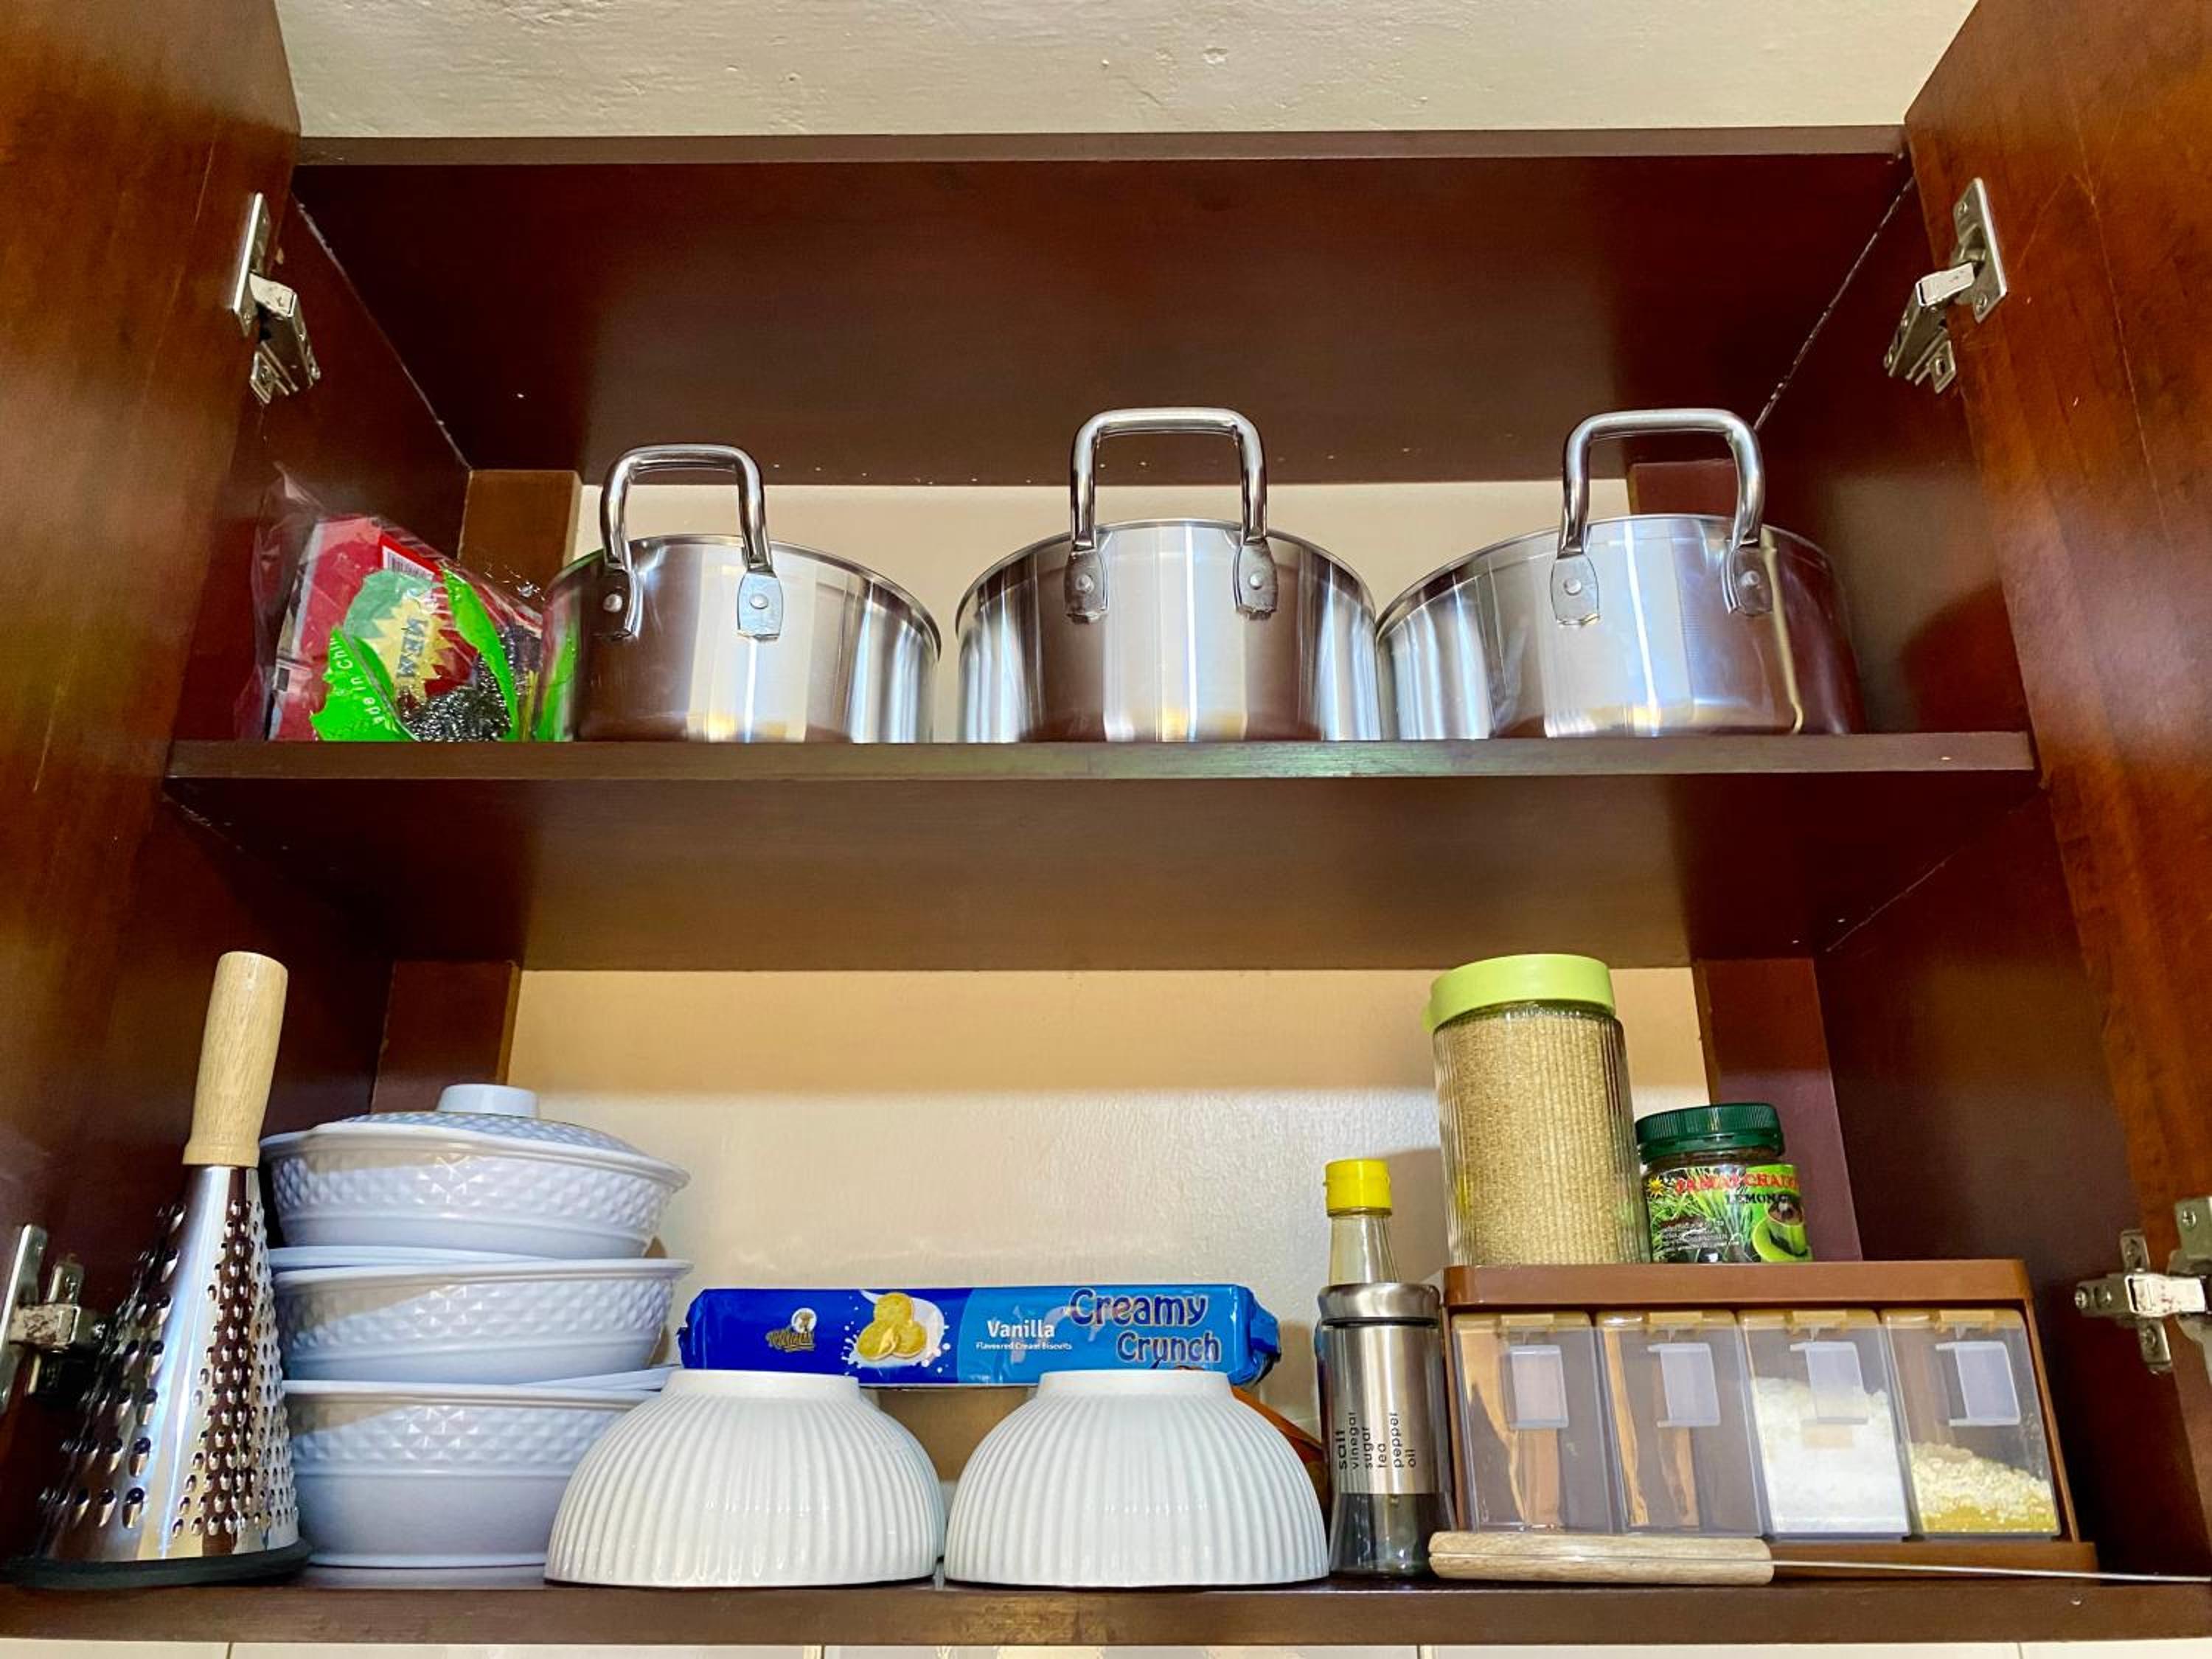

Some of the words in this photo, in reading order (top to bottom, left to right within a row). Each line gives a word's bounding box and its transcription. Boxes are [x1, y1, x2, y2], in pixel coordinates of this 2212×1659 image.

[1069, 1288, 1208, 1327] Creamy
[987, 1320, 1055, 1338] Vanilla
[1116, 1330, 1222, 1363] Crunch
[1335, 1429, 1347, 1470] salt
[1348, 1412, 1360, 1470] vinegar
[1362, 1427, 1374, 1470] sugar
[1377, 1443, 1388, 1469] tea
[1390, 1412, 1405, 1469] pepper
[1405, 1449, 1416, 1468] oil
